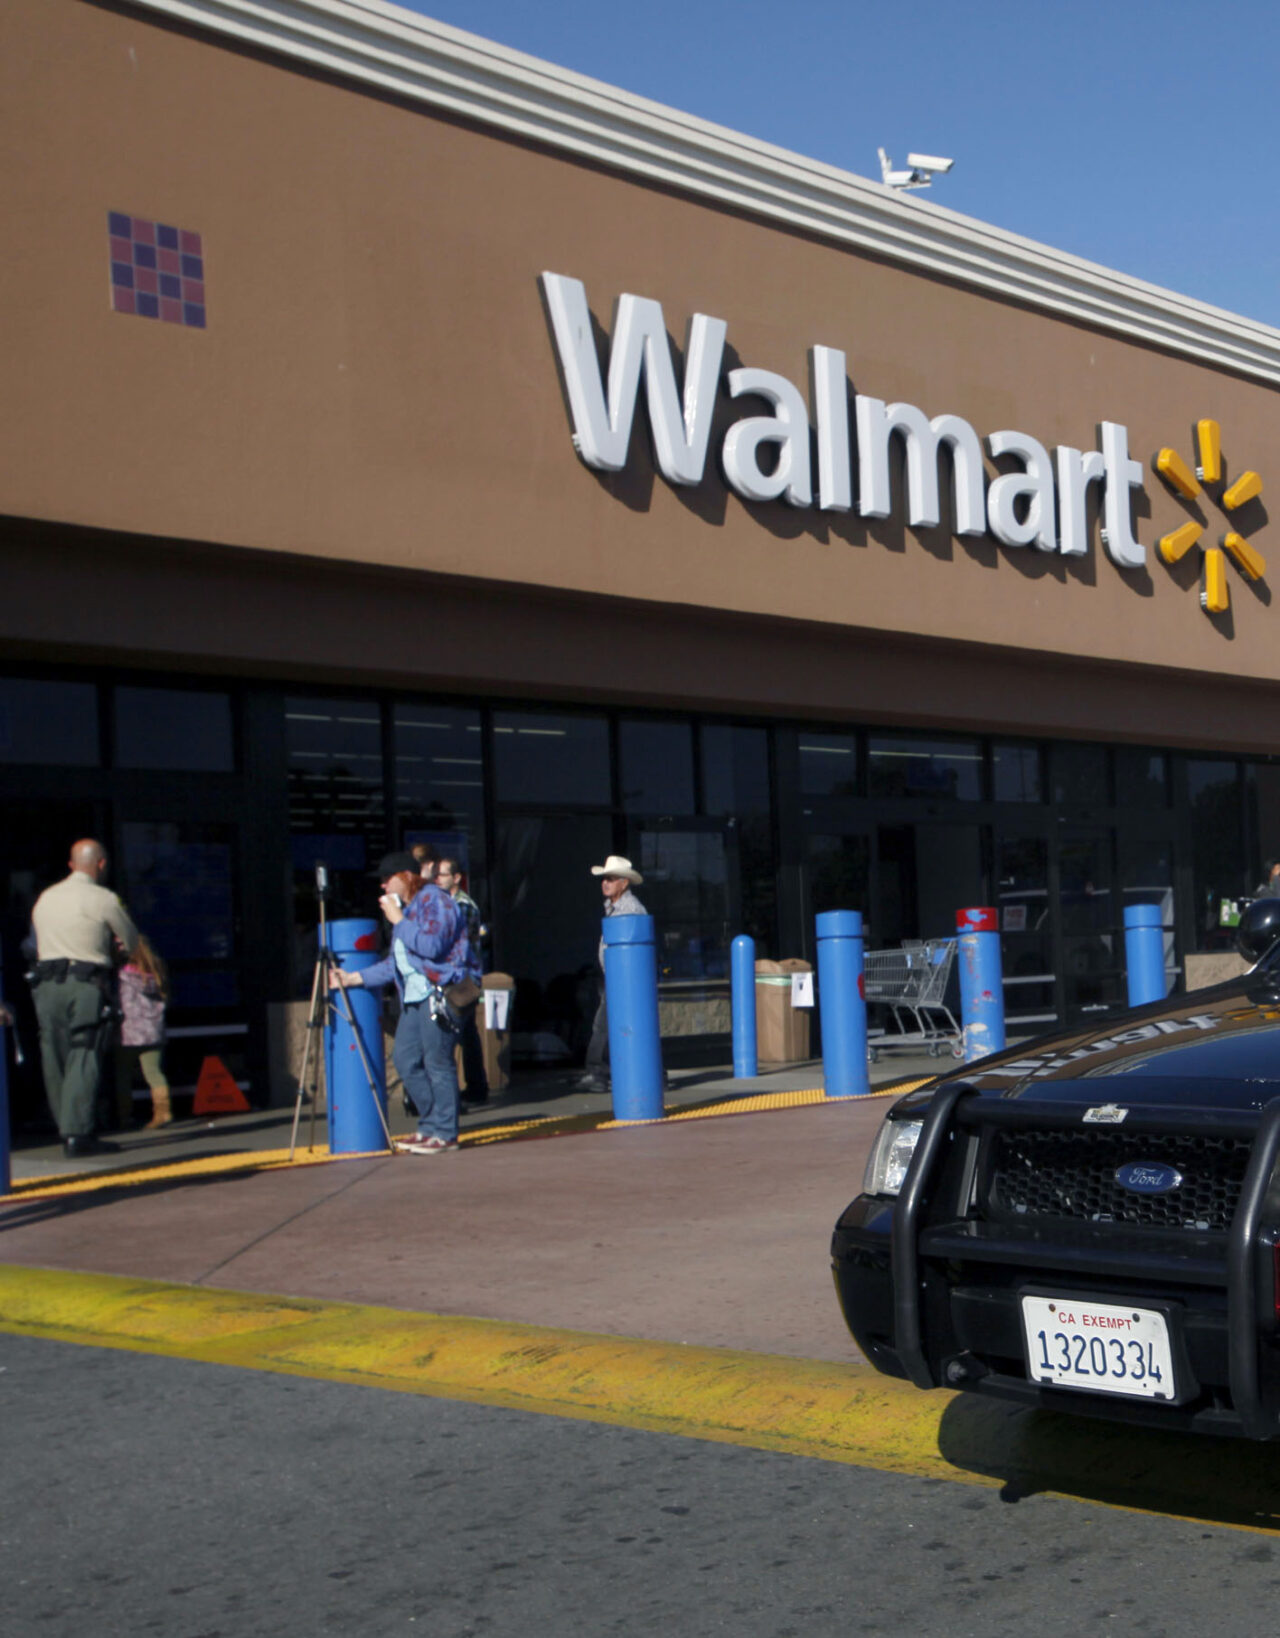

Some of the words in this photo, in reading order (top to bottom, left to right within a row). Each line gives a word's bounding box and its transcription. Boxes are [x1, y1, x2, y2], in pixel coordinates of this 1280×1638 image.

[539, 271, 1146, 568] Walmart
[1128, 1167, 1164, 1186] Ford
[1058, 1311, 1076, 1324] CA
[1082, 1314, 1132, 1331] EXEMPT
[1038, 1330, 1162, 1384] 1320334
